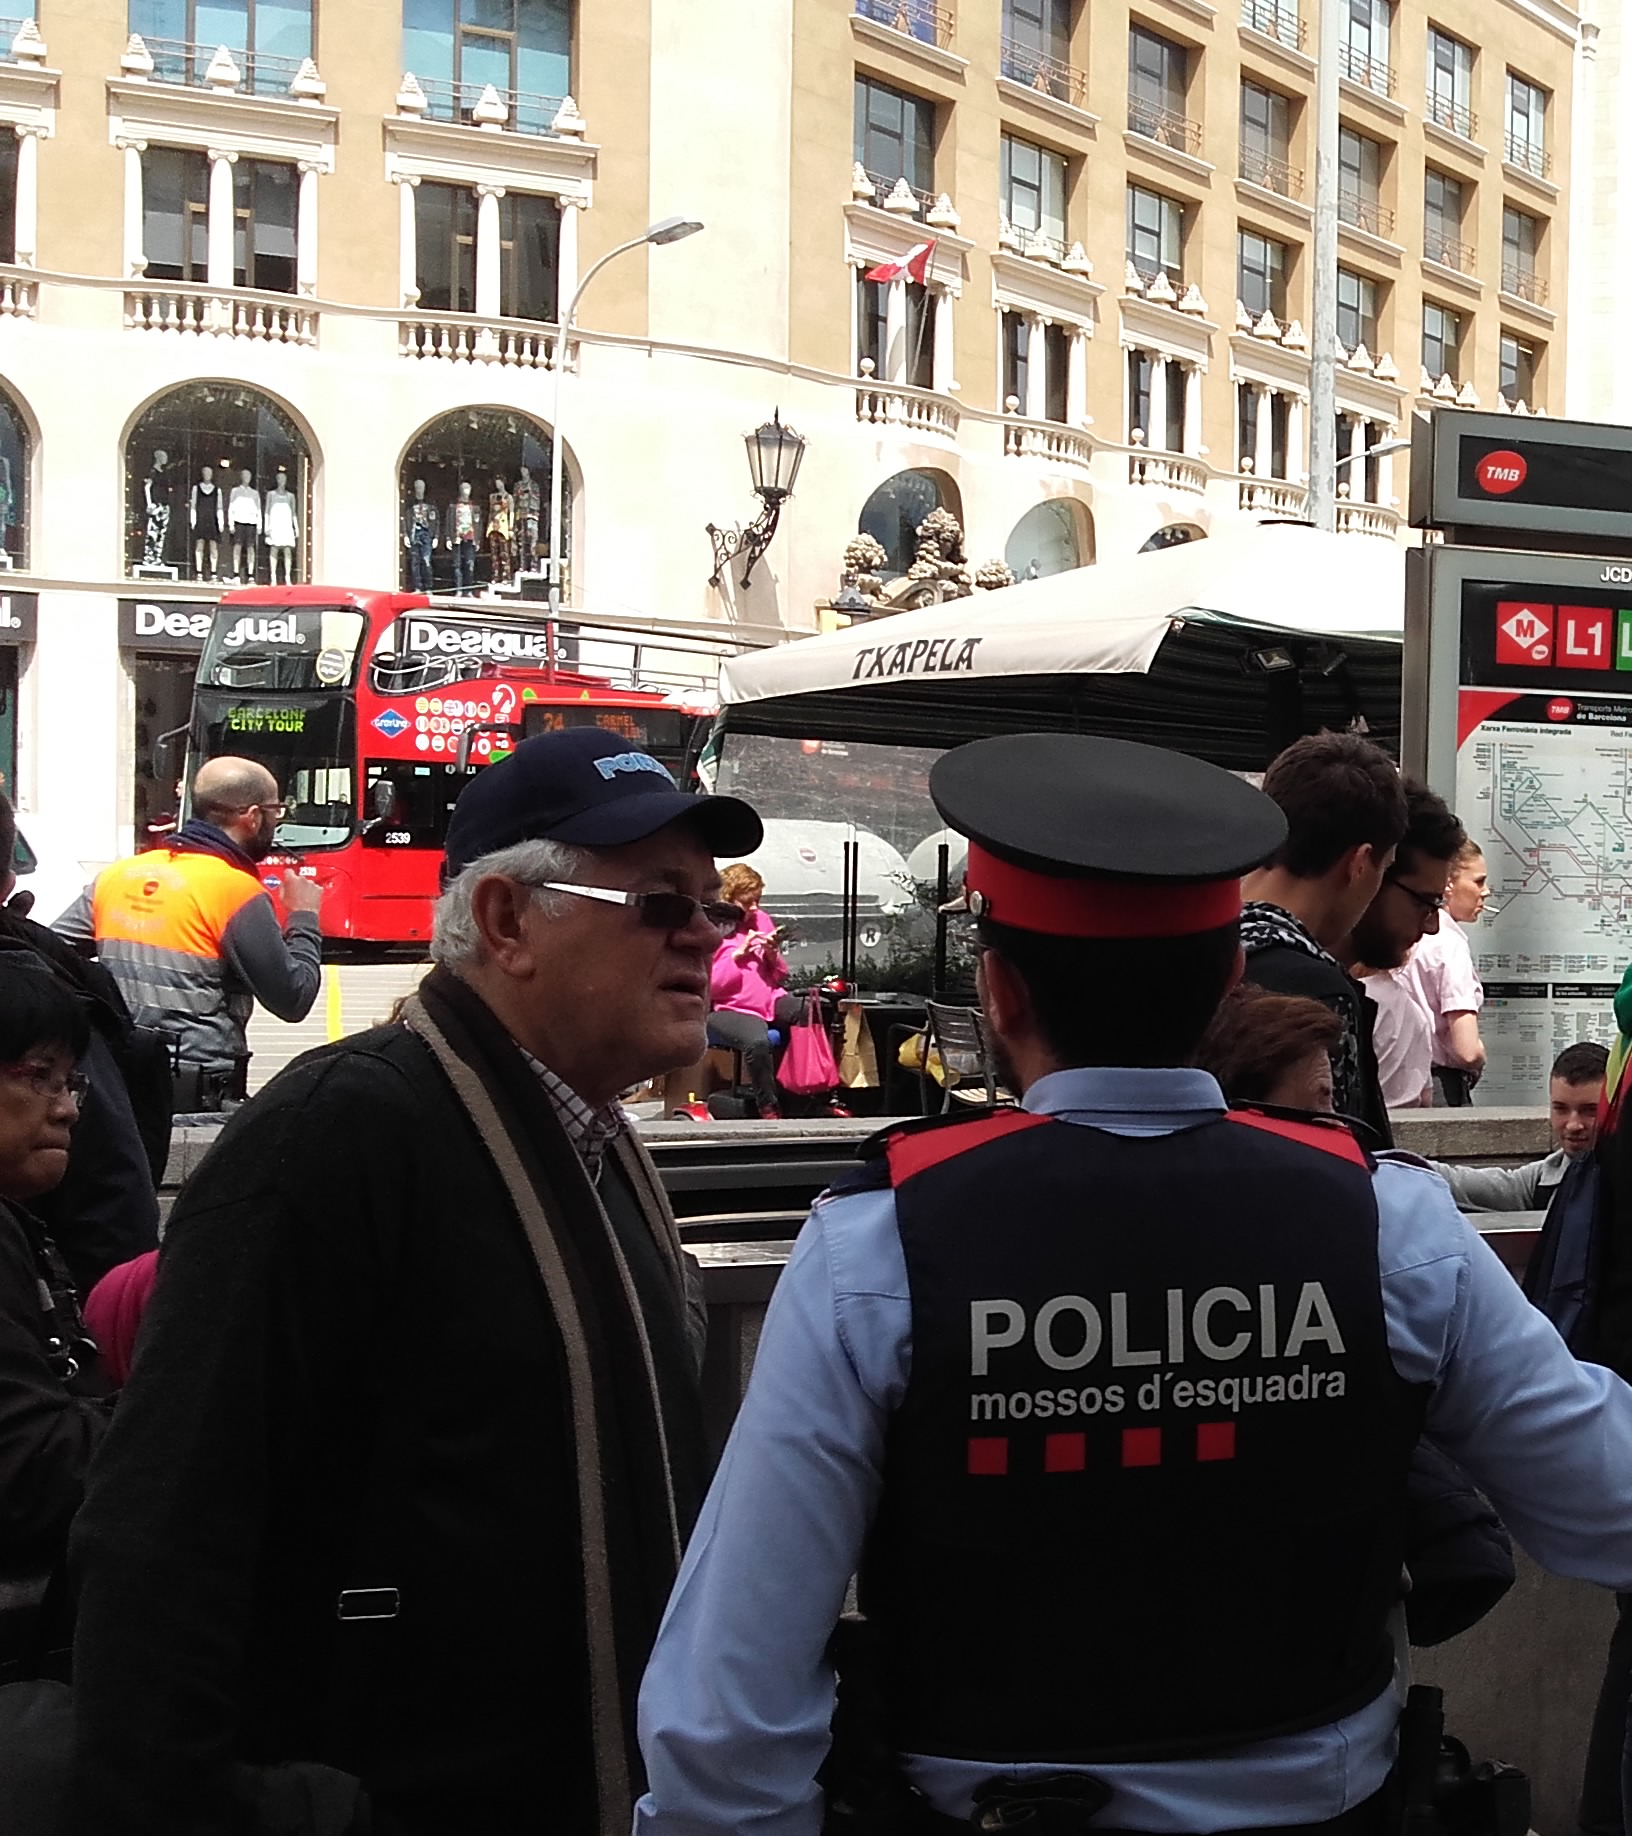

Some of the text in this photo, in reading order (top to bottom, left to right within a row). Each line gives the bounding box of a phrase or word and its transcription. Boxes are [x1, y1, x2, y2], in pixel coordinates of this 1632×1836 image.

[1486, 465, 1520, 483] TMB
[410, 621, 558, 662] Desigua
[1515, 618, 1535, 638] M
[1566, 619, 1603, 656] L1
[852, 637, 984, 680] TXAPELA
[231, 719, 304, 732] CITY TOUR
[1588, 713, 1627, 723] Barcelona
[1480, 724, 1500, 732] Xarxa
[1610, 730, 1623, 738] Red
[385, 832, 411, 844] 2539
[970, 1281, 1346, 1377] POLICIA
[970, 1385, 1125, 1421] mossos
